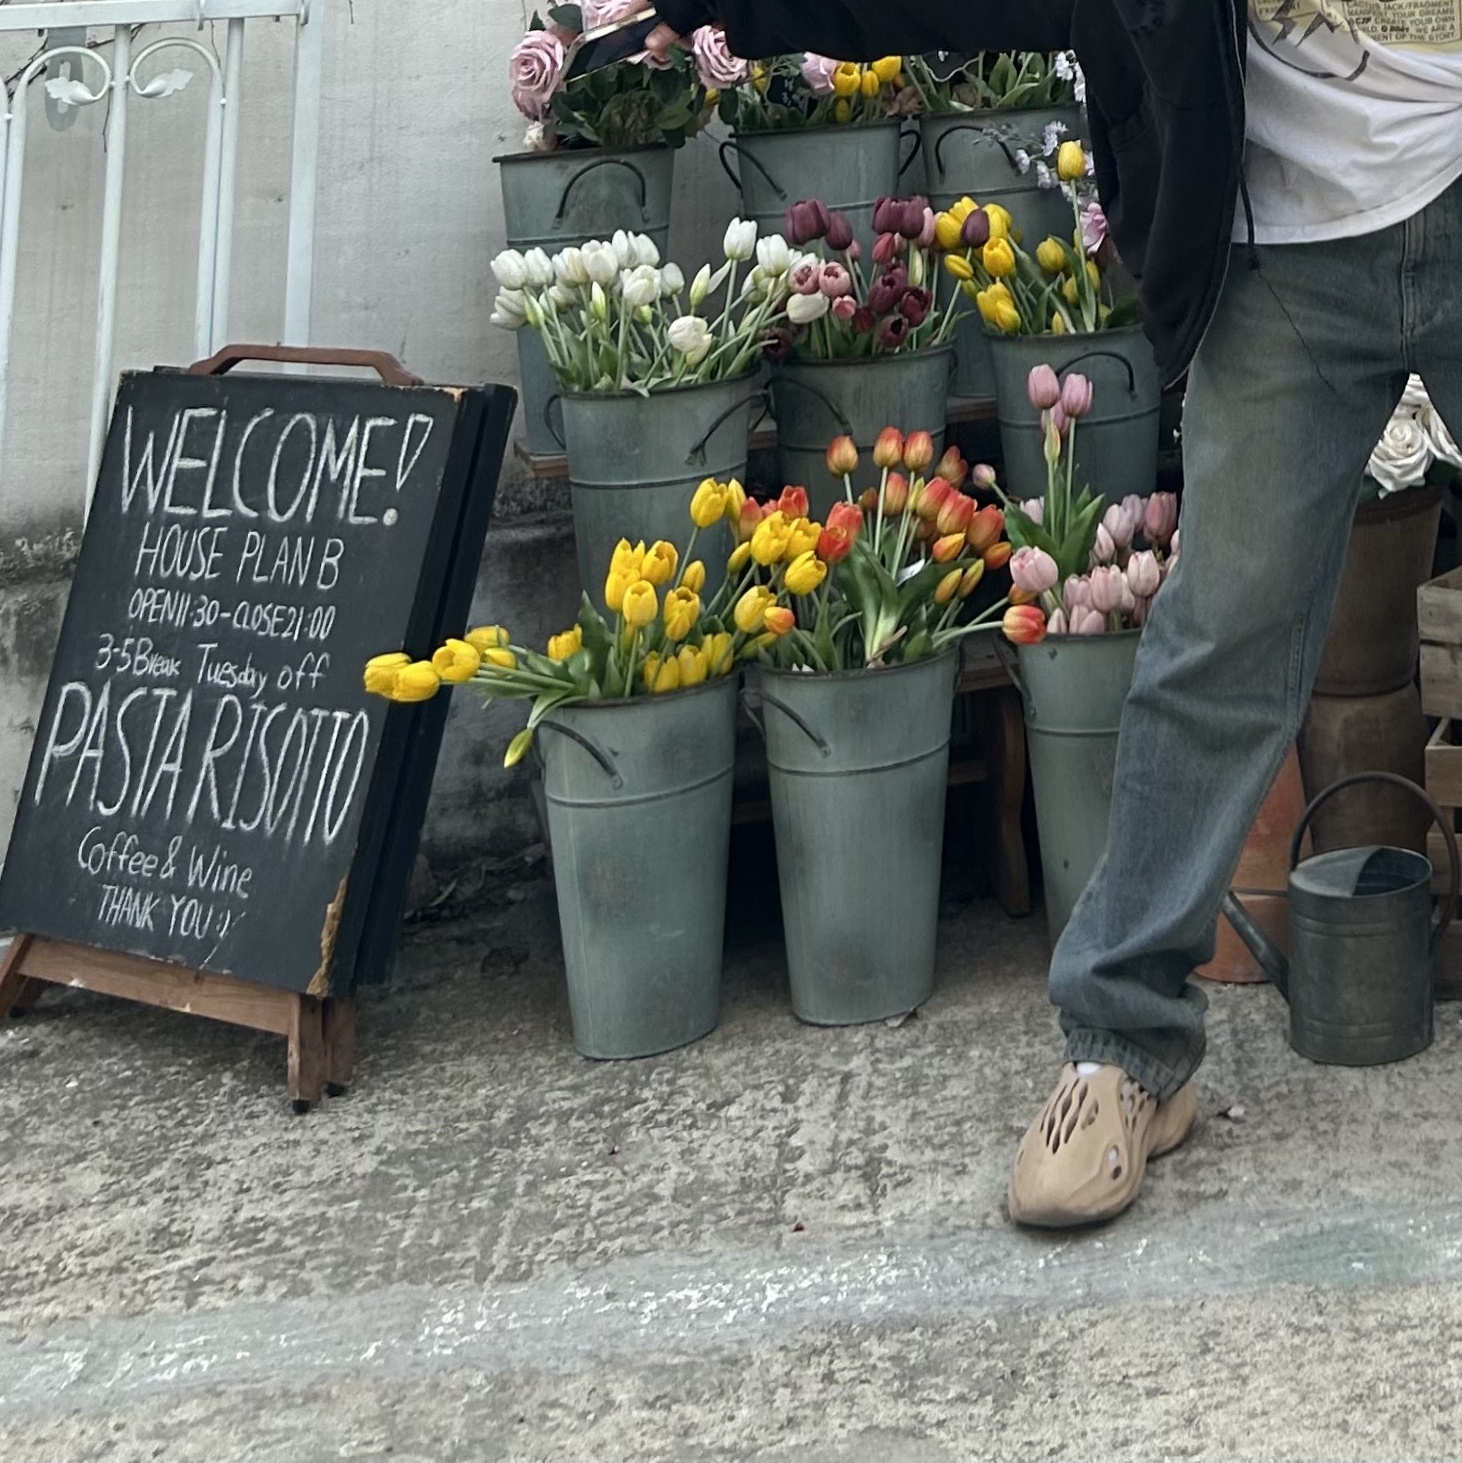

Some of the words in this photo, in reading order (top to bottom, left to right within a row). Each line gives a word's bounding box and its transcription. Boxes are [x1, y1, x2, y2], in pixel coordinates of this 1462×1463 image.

[121, 404, 434, 526] WELCOME!
[134, 521, 228, 581] HOUSE
[197, 642, 269, 699] Tuesday
[277, 651, 331, 690] off
[34, 679, 193, 822] PASTA
[187, 693, 370, 846] RISOTTO
[187, 844, 252, 899] Wine
[98, 884, 160, 932] THANK
